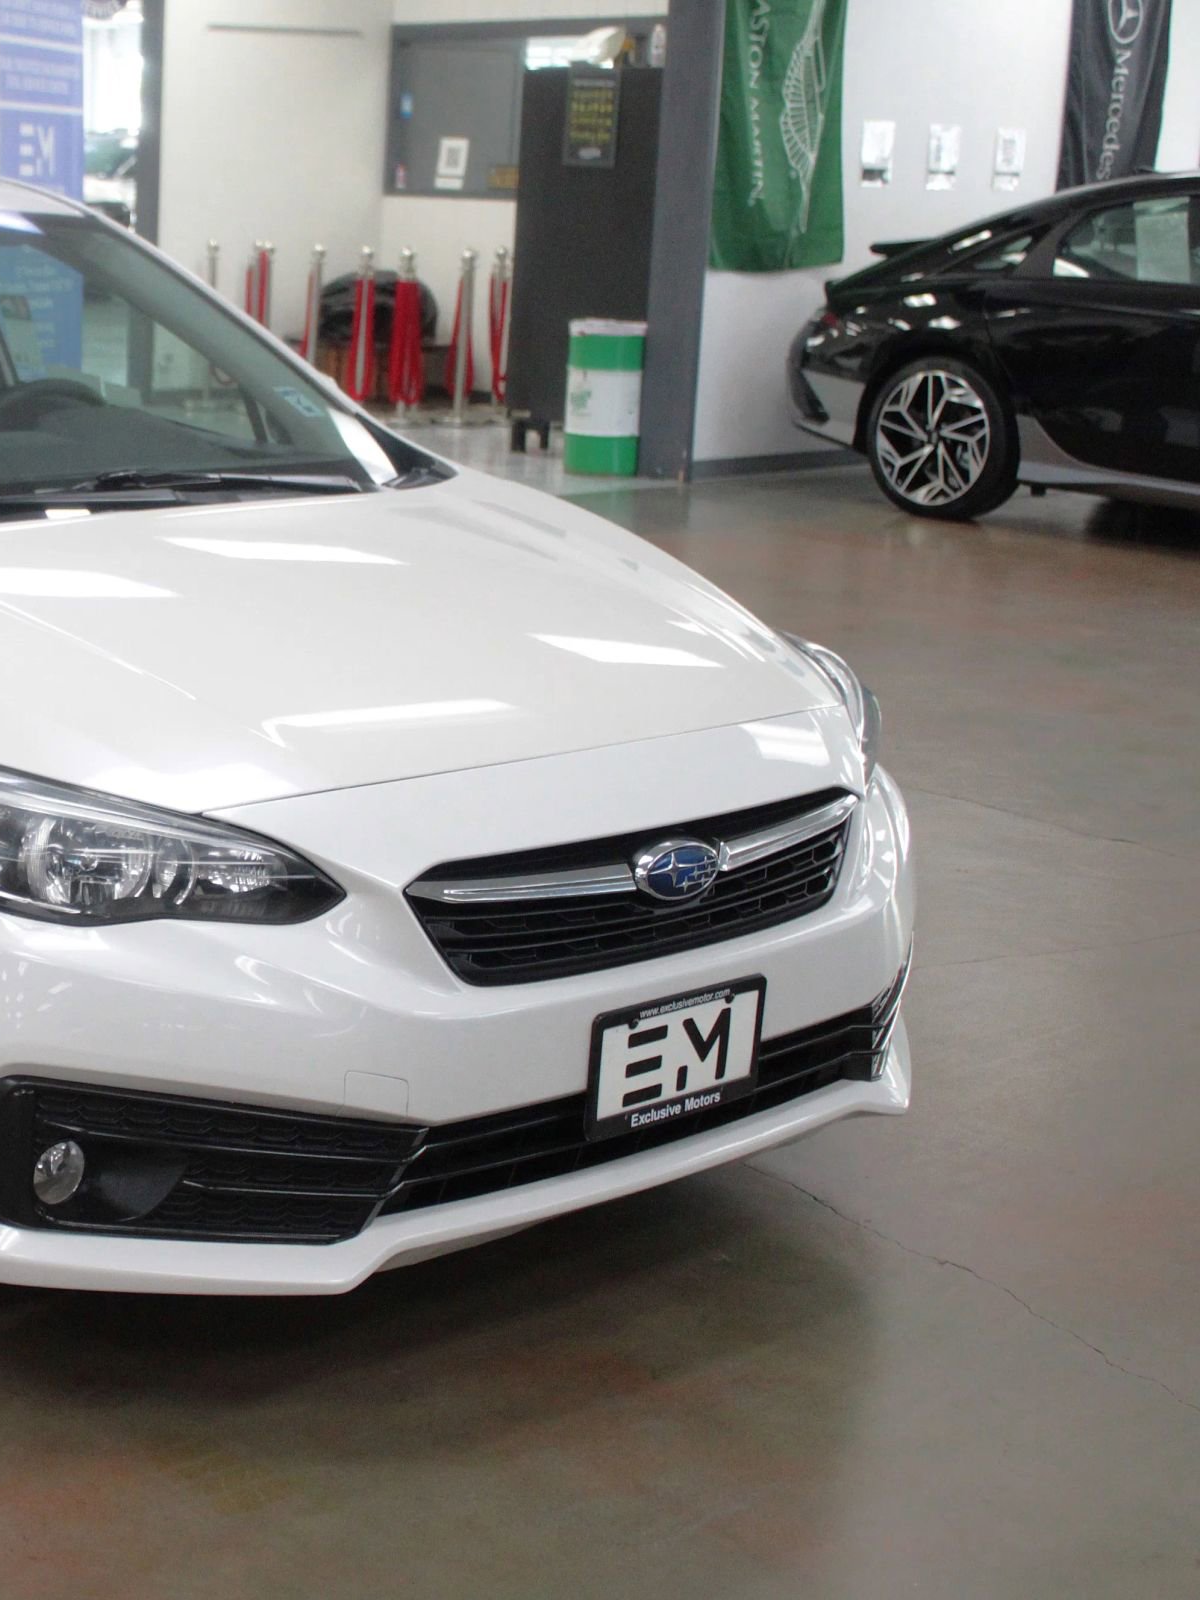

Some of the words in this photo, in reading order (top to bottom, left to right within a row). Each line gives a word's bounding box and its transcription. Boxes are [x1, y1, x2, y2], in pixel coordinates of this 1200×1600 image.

[639, 988, 731, 1019] www.exclusivemotor.com
[622, 1007, 732, 1107] EM
[630, 1103, 682, 1128] Exclusive
[684, 1090, 721, 1112] Motors
